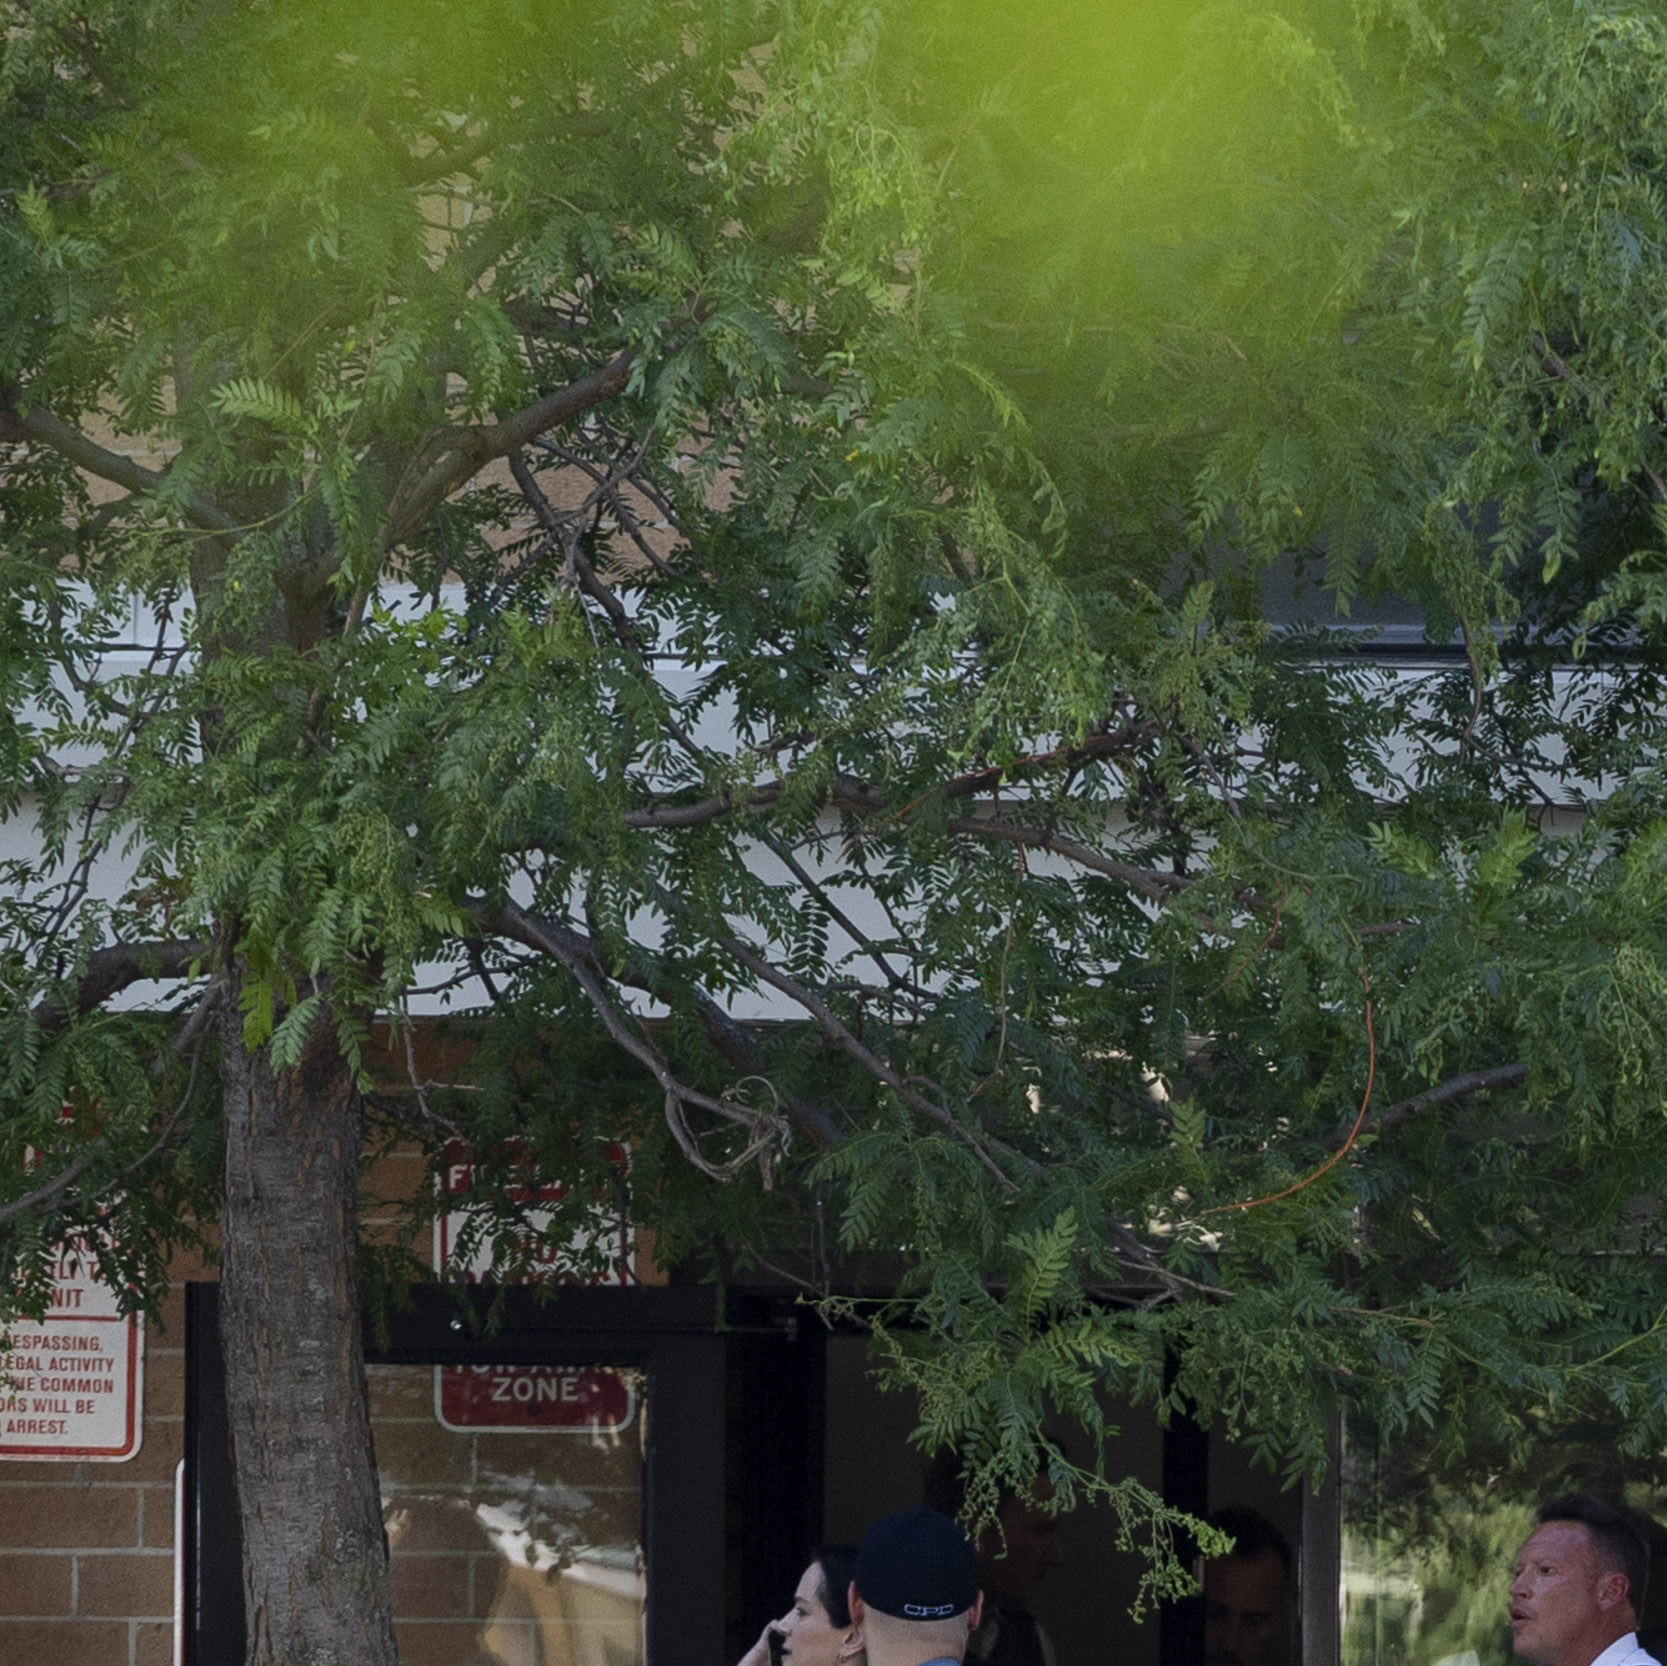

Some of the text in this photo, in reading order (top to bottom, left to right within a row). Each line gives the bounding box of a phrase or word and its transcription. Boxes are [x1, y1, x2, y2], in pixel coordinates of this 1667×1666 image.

[49, 1288, 85, 1308] NIT
[9, 1334, 104, 1352] ESPASSING,
[49, 1356, 115, 1373] ACTIVITY
[40, 1377, 114, 1394] COMMON
[491, 1377, 579, 1402] ZONE
[33, 1398, 71, 1414] WILL
[75, 1399, 96, 1415] BE
[6, 1419, 69, 1435] ARREST.
[904, 1603, 954, 1616] CPD
